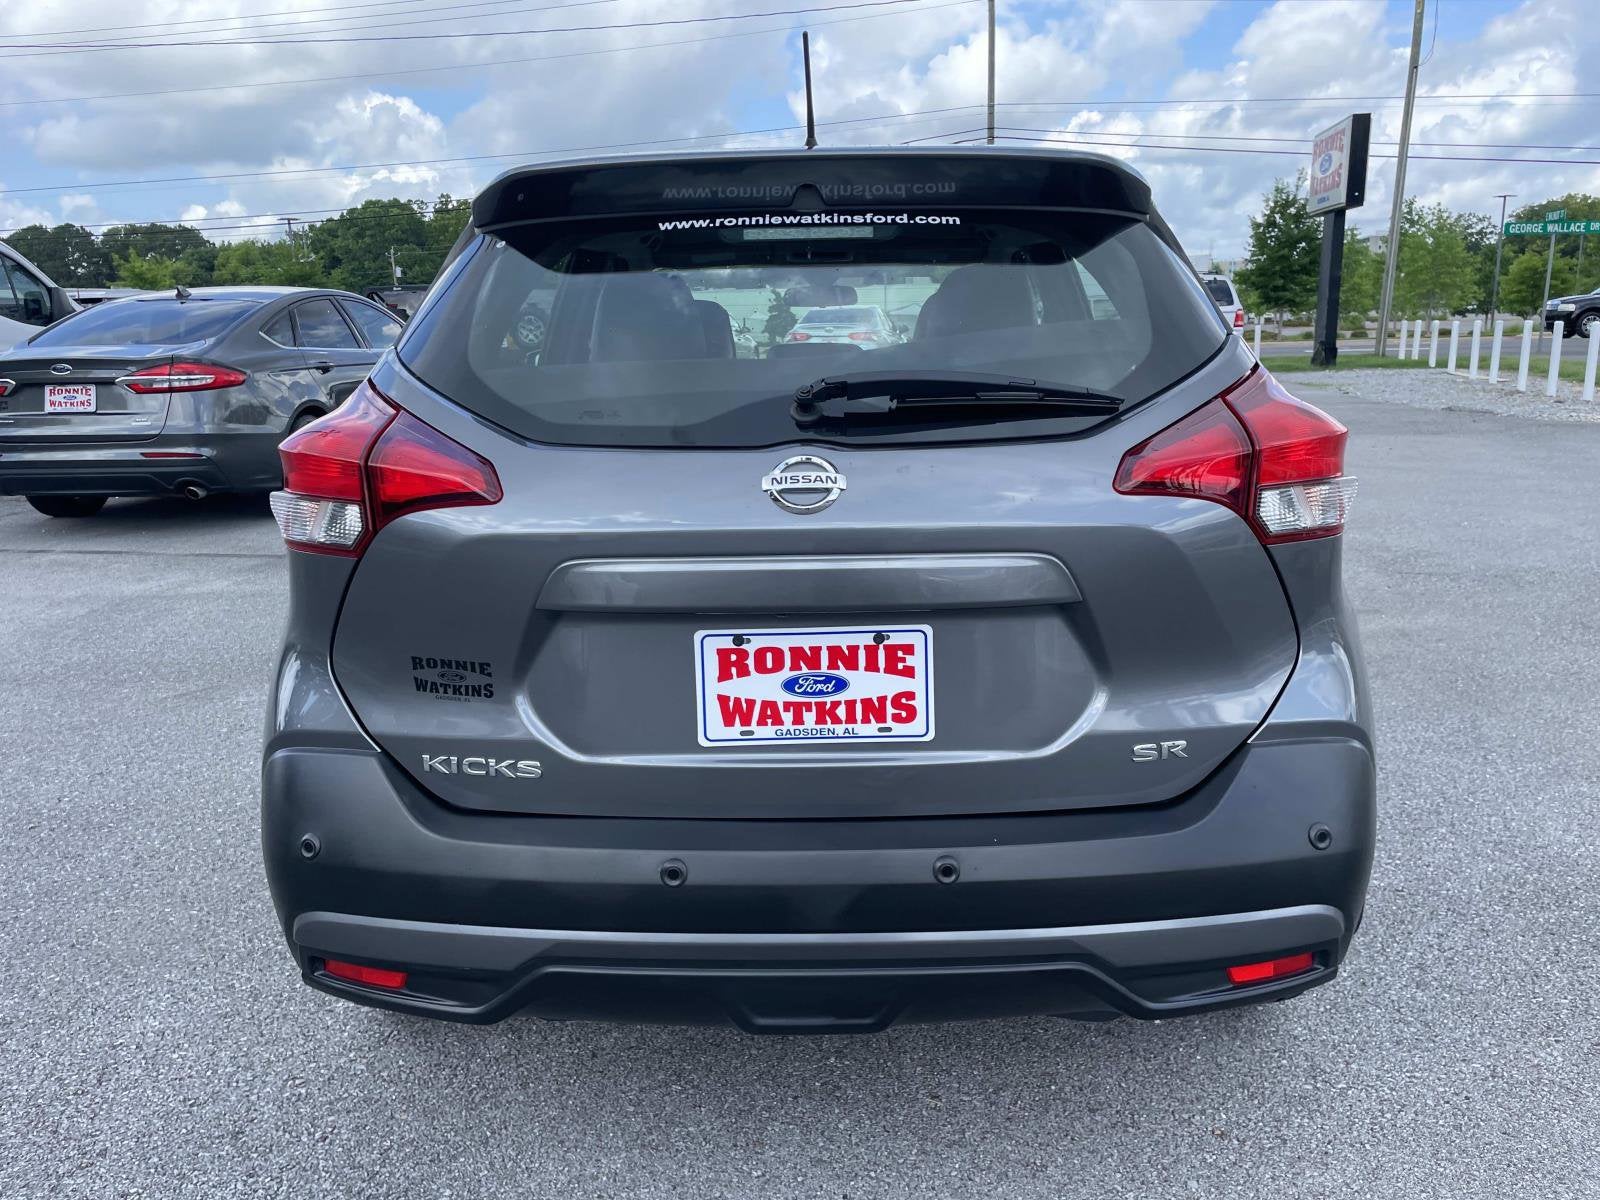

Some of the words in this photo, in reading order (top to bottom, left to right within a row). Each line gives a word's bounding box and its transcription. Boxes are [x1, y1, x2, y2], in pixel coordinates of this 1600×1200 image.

[658, 213, 961, 230] www.ronniewatkinsford.com
[1509, 223, 1543, 233] GEORGE
[1547, 222, 1585, 232] WALLACE
[1590, 222, 1600, 231] DR
[48, 387, 92, 397] RONNIE
[48, 398, 92, 408] WATKINS
[771, 475, 838, 486] NISSAN
[411, 656, 493, 678] RONNIE
[716, 643, 916, 683] RONNIE
[413, 676, 494, 699] WATKINS
[794, 676, 836, 694] Ford
[716, 691, 918, 728] WATKINS
[774, 728, 840, 738] GADSDEN,
[843, 727, 860, 736] AL
[1132, 740, 1188, 762] SR
[421, 754, 542, 779] KICKS
